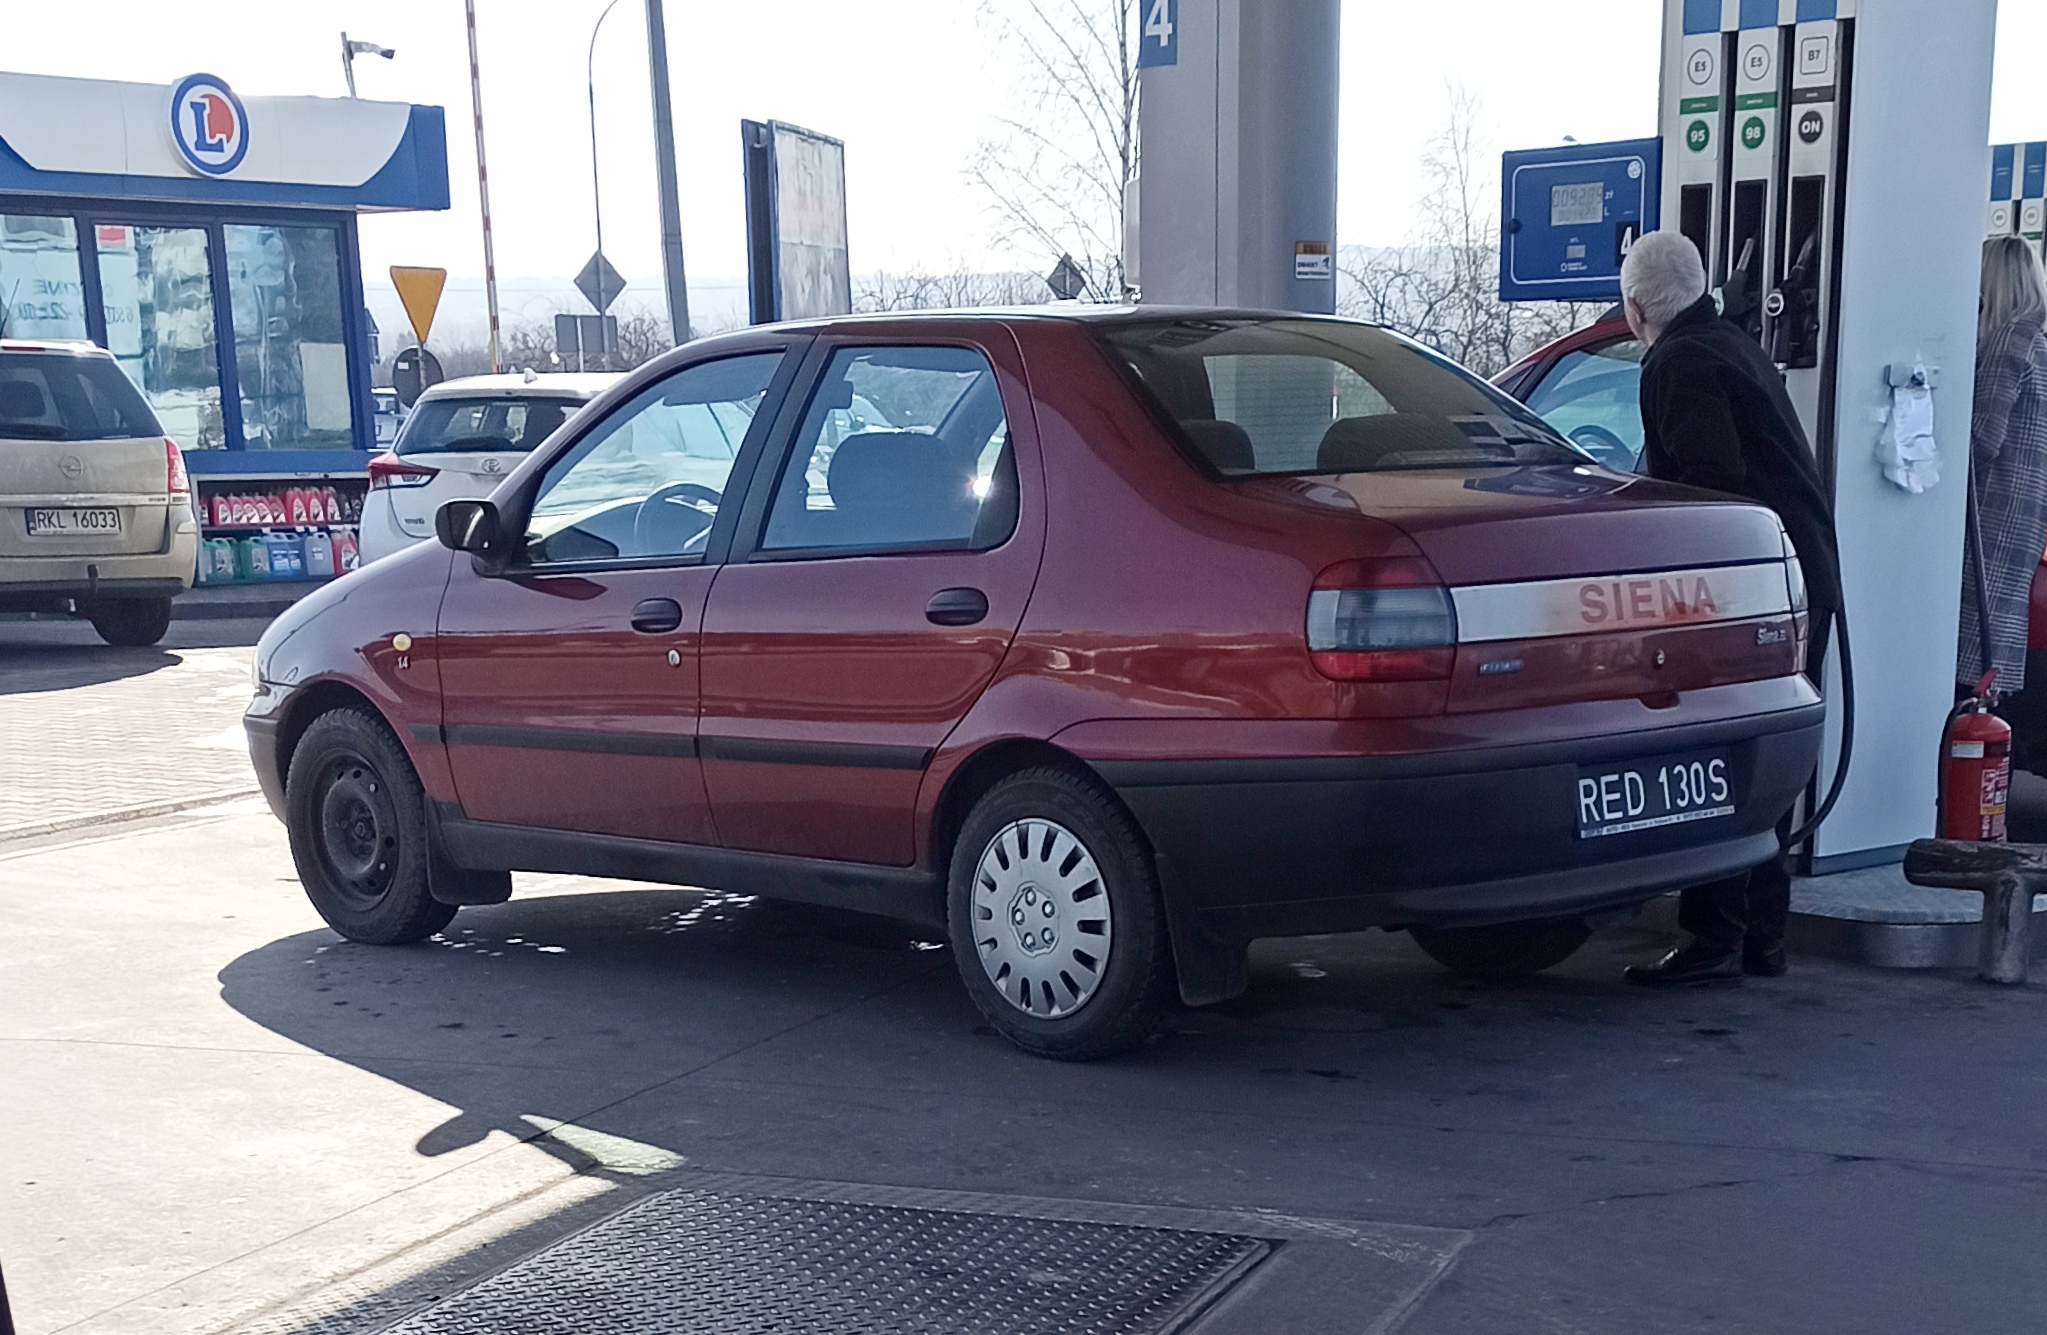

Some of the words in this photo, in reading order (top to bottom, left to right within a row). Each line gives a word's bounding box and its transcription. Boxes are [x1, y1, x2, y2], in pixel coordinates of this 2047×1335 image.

[1145, 0, 1172, 47] 4
[1751, 57, 1763, 68] E5
[1808, 50, 1820, 61] B7
[1695, 61, 1706, 72] E5
[190, 101, 225, 153] L
[1746, 126, 1761, 139] 98
[1801, 120, 1820, 133] ON
[1690, 130, 1705, 142] 95
[1620, 227, 1632, 255] 4
[36, 511, 67, 529] RKL
[72, 511, 118, 529] 16033
[1579, 576, 1718, 624] SIENA
[1578, 771, 1645, 824] RED
[1658, 758, 1728, 810] 130S
